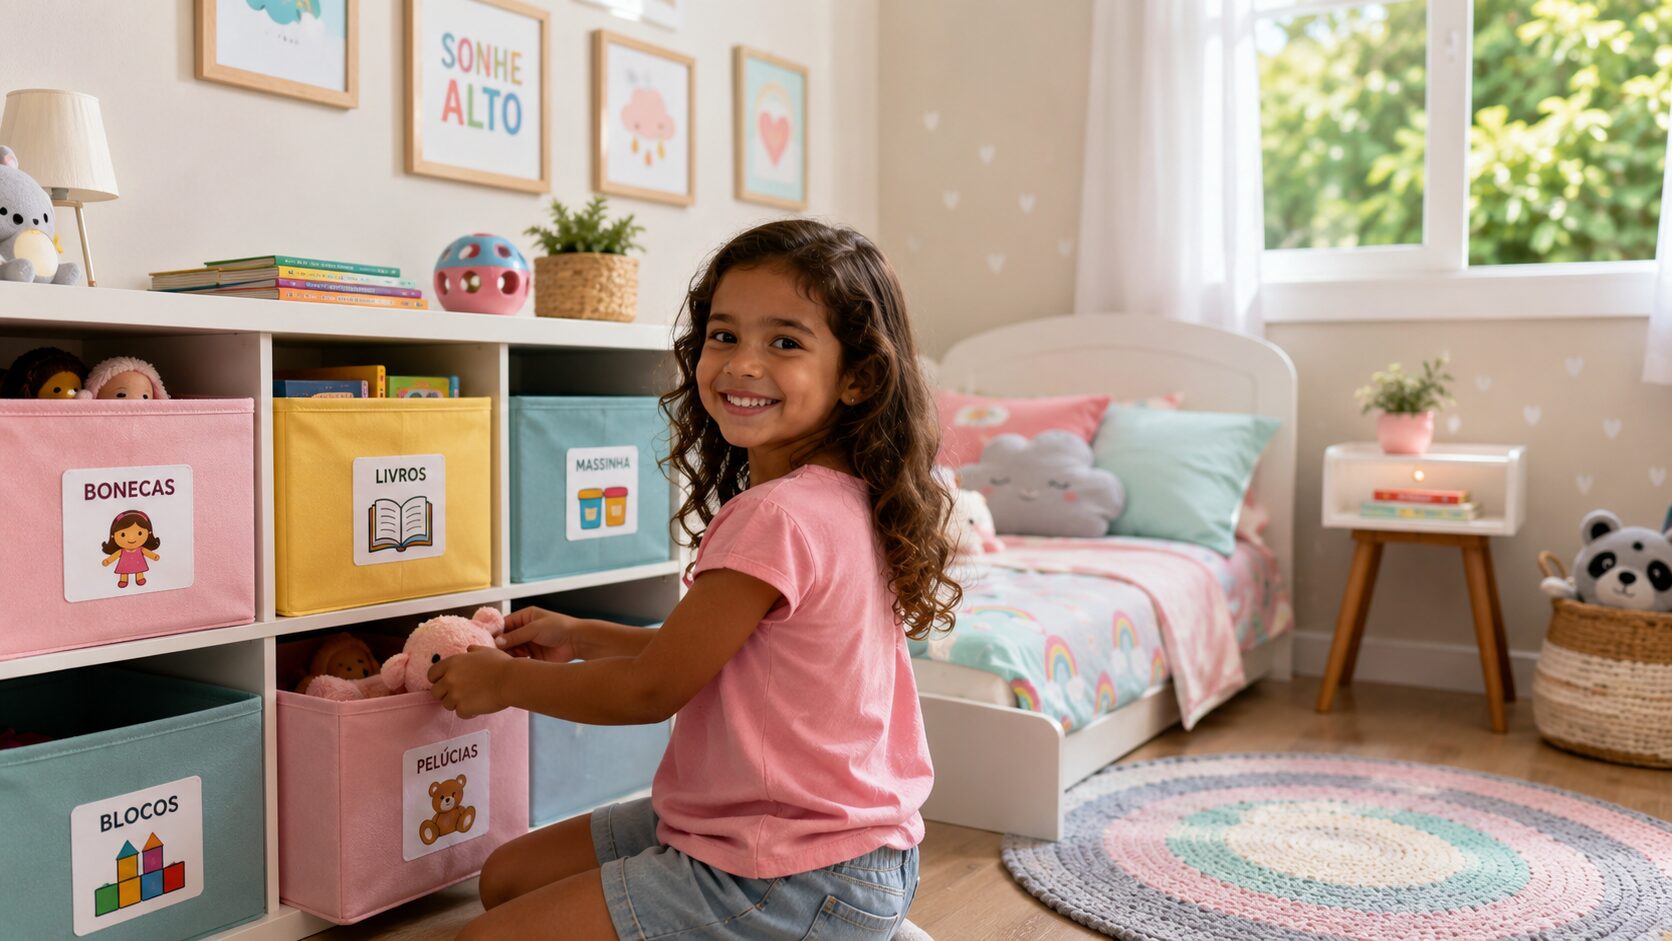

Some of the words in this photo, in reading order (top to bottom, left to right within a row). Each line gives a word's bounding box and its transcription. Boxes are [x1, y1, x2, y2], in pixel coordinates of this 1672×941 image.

[441, 32, 523, 85] SONHE
[441, 79, 522, 136] ALTO
[376, 467, 426, 484] LIVROS
[576, 457, 630, 472] MASSINHA
[84, 479, 175, 501] BONECAS
[417, 744, 478, 774] PELÚCIAS
[100, 795, 179, 832] BLOCOS
